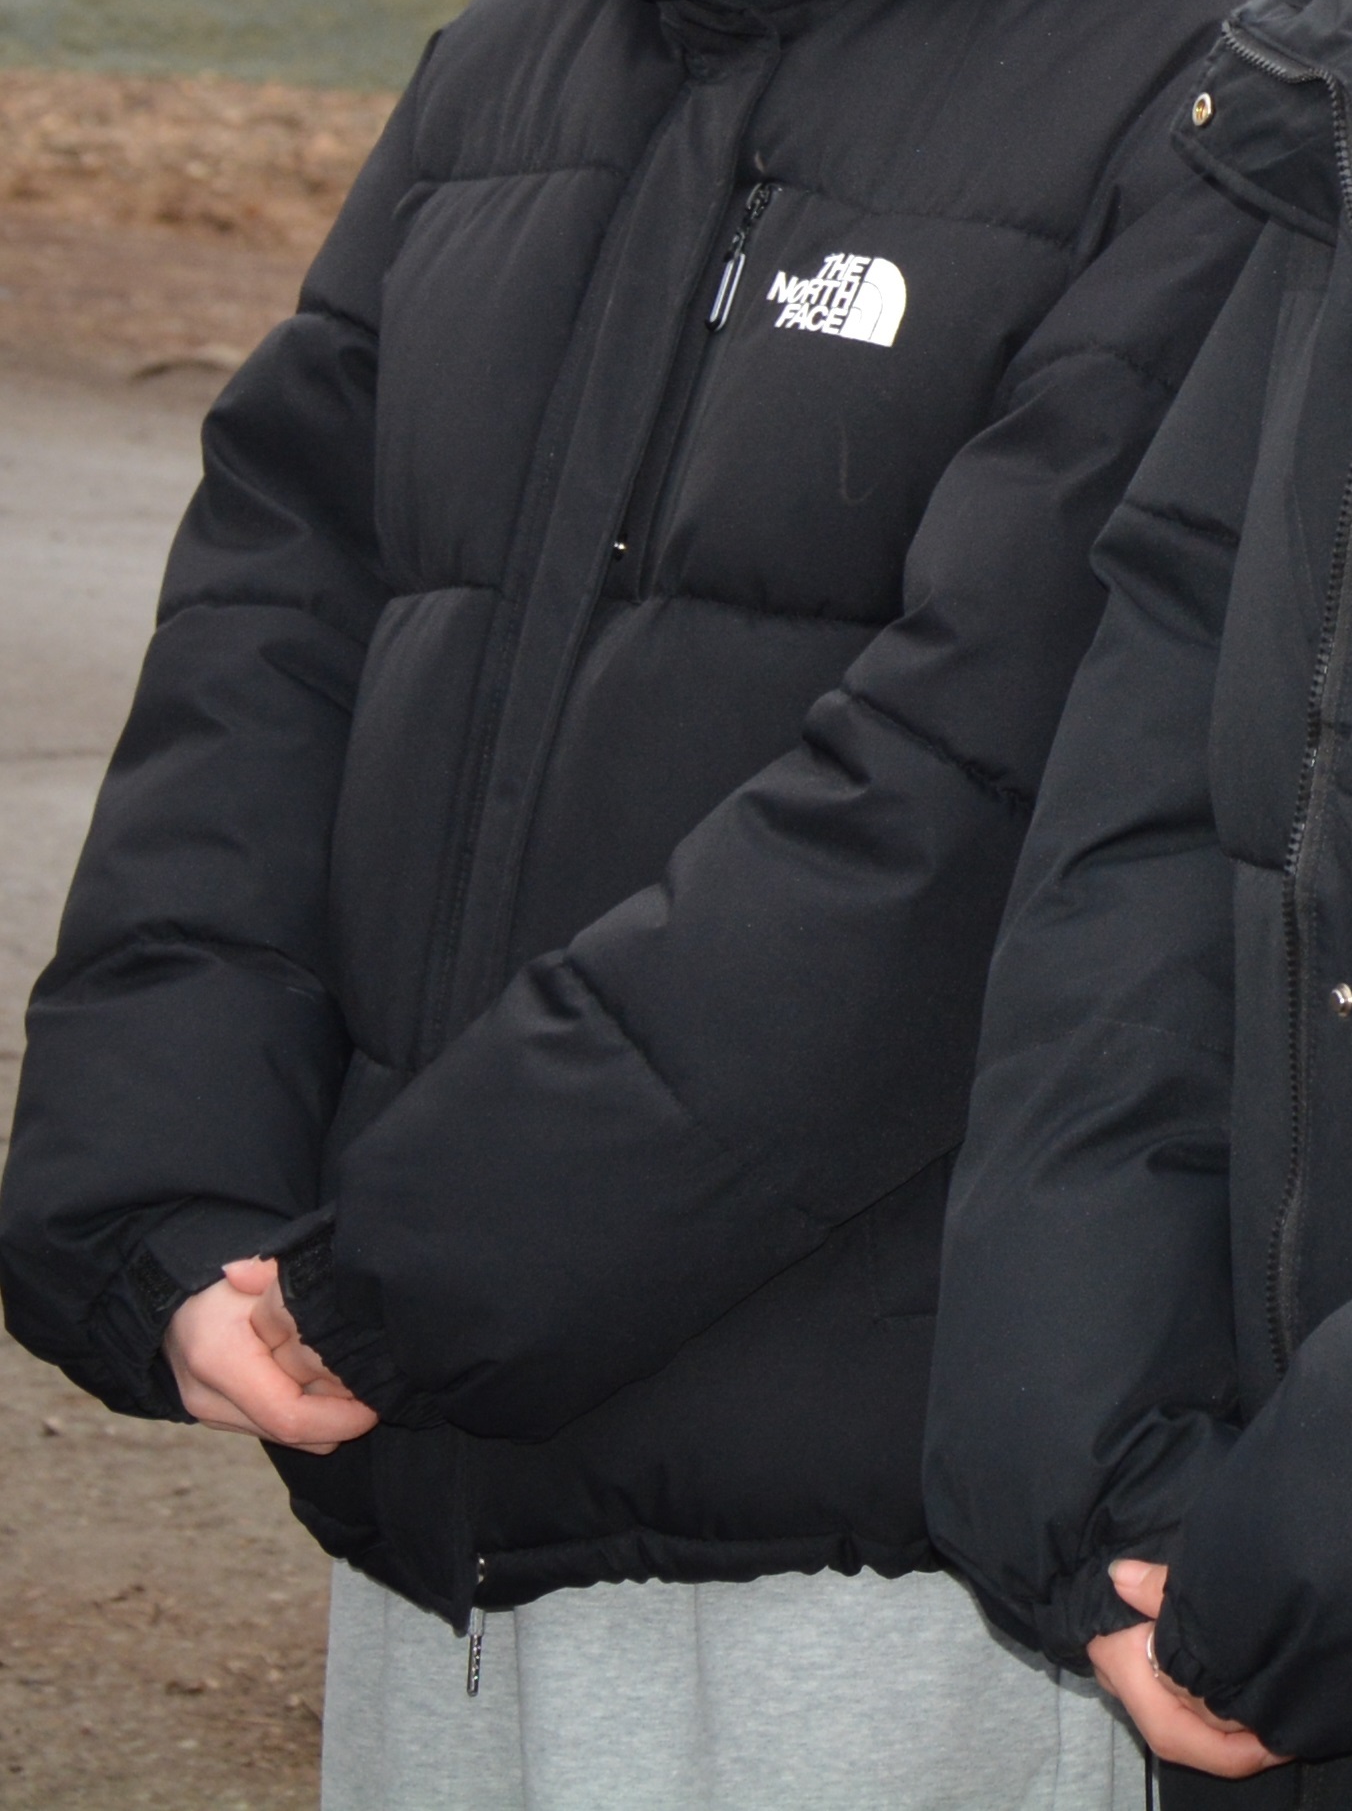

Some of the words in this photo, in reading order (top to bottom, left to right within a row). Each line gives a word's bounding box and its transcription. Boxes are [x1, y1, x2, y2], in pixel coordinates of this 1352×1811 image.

[816, 253, 871, 281] THE
[766, 270, 859, 310] NORTH
[774, 303, 849, 334] FACE
